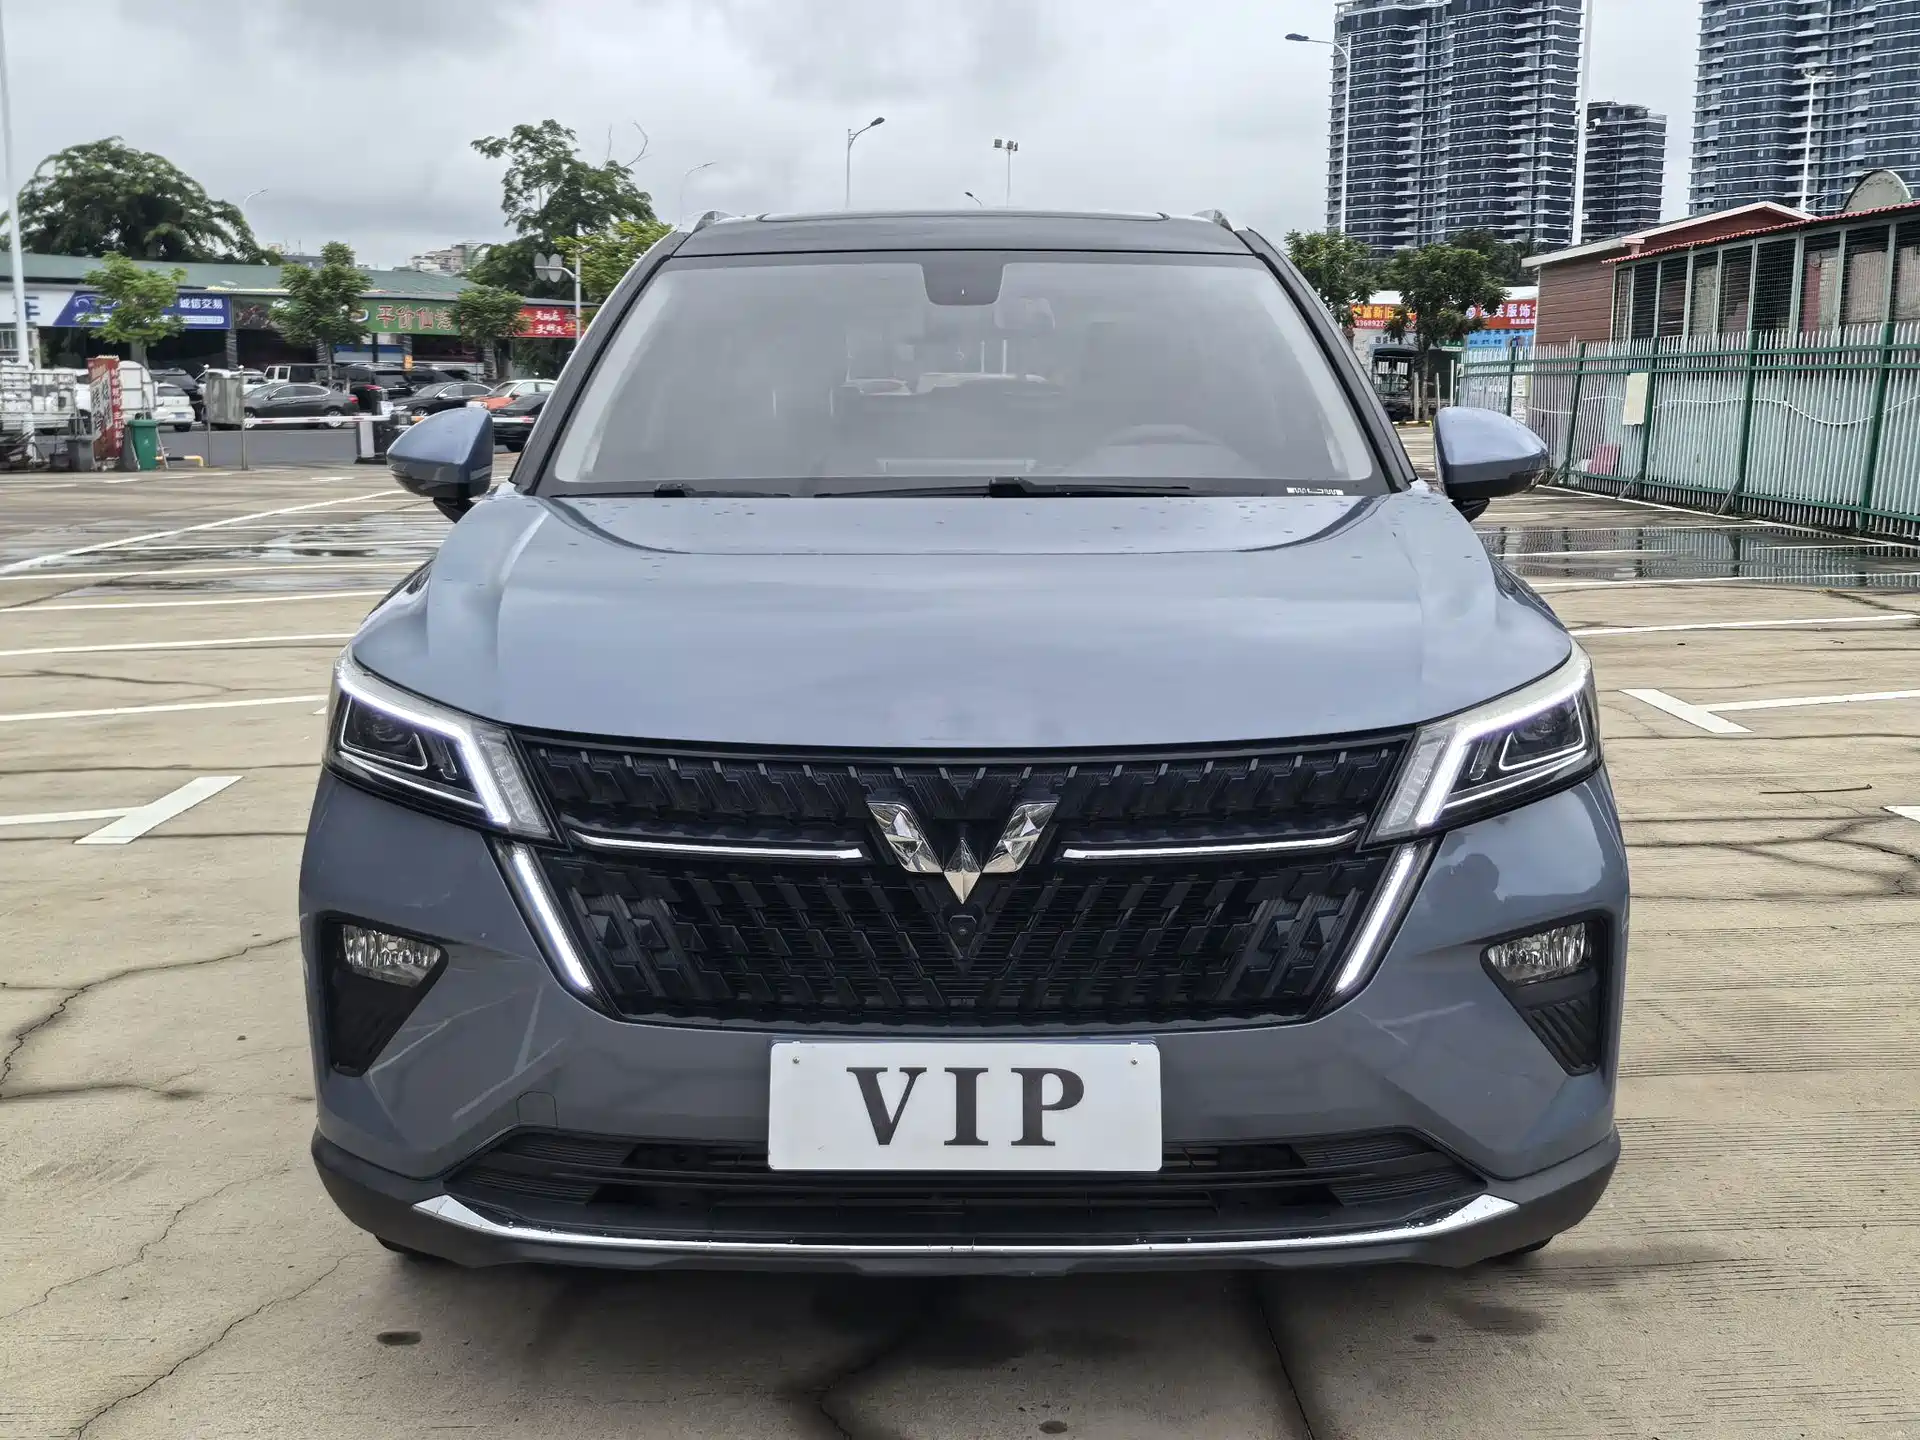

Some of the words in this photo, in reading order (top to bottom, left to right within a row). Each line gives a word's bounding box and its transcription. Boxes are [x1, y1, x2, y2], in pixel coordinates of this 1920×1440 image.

[180, 297, 223, 309] 诚信交易
[846, 1066, 1085, 1147] VIP
